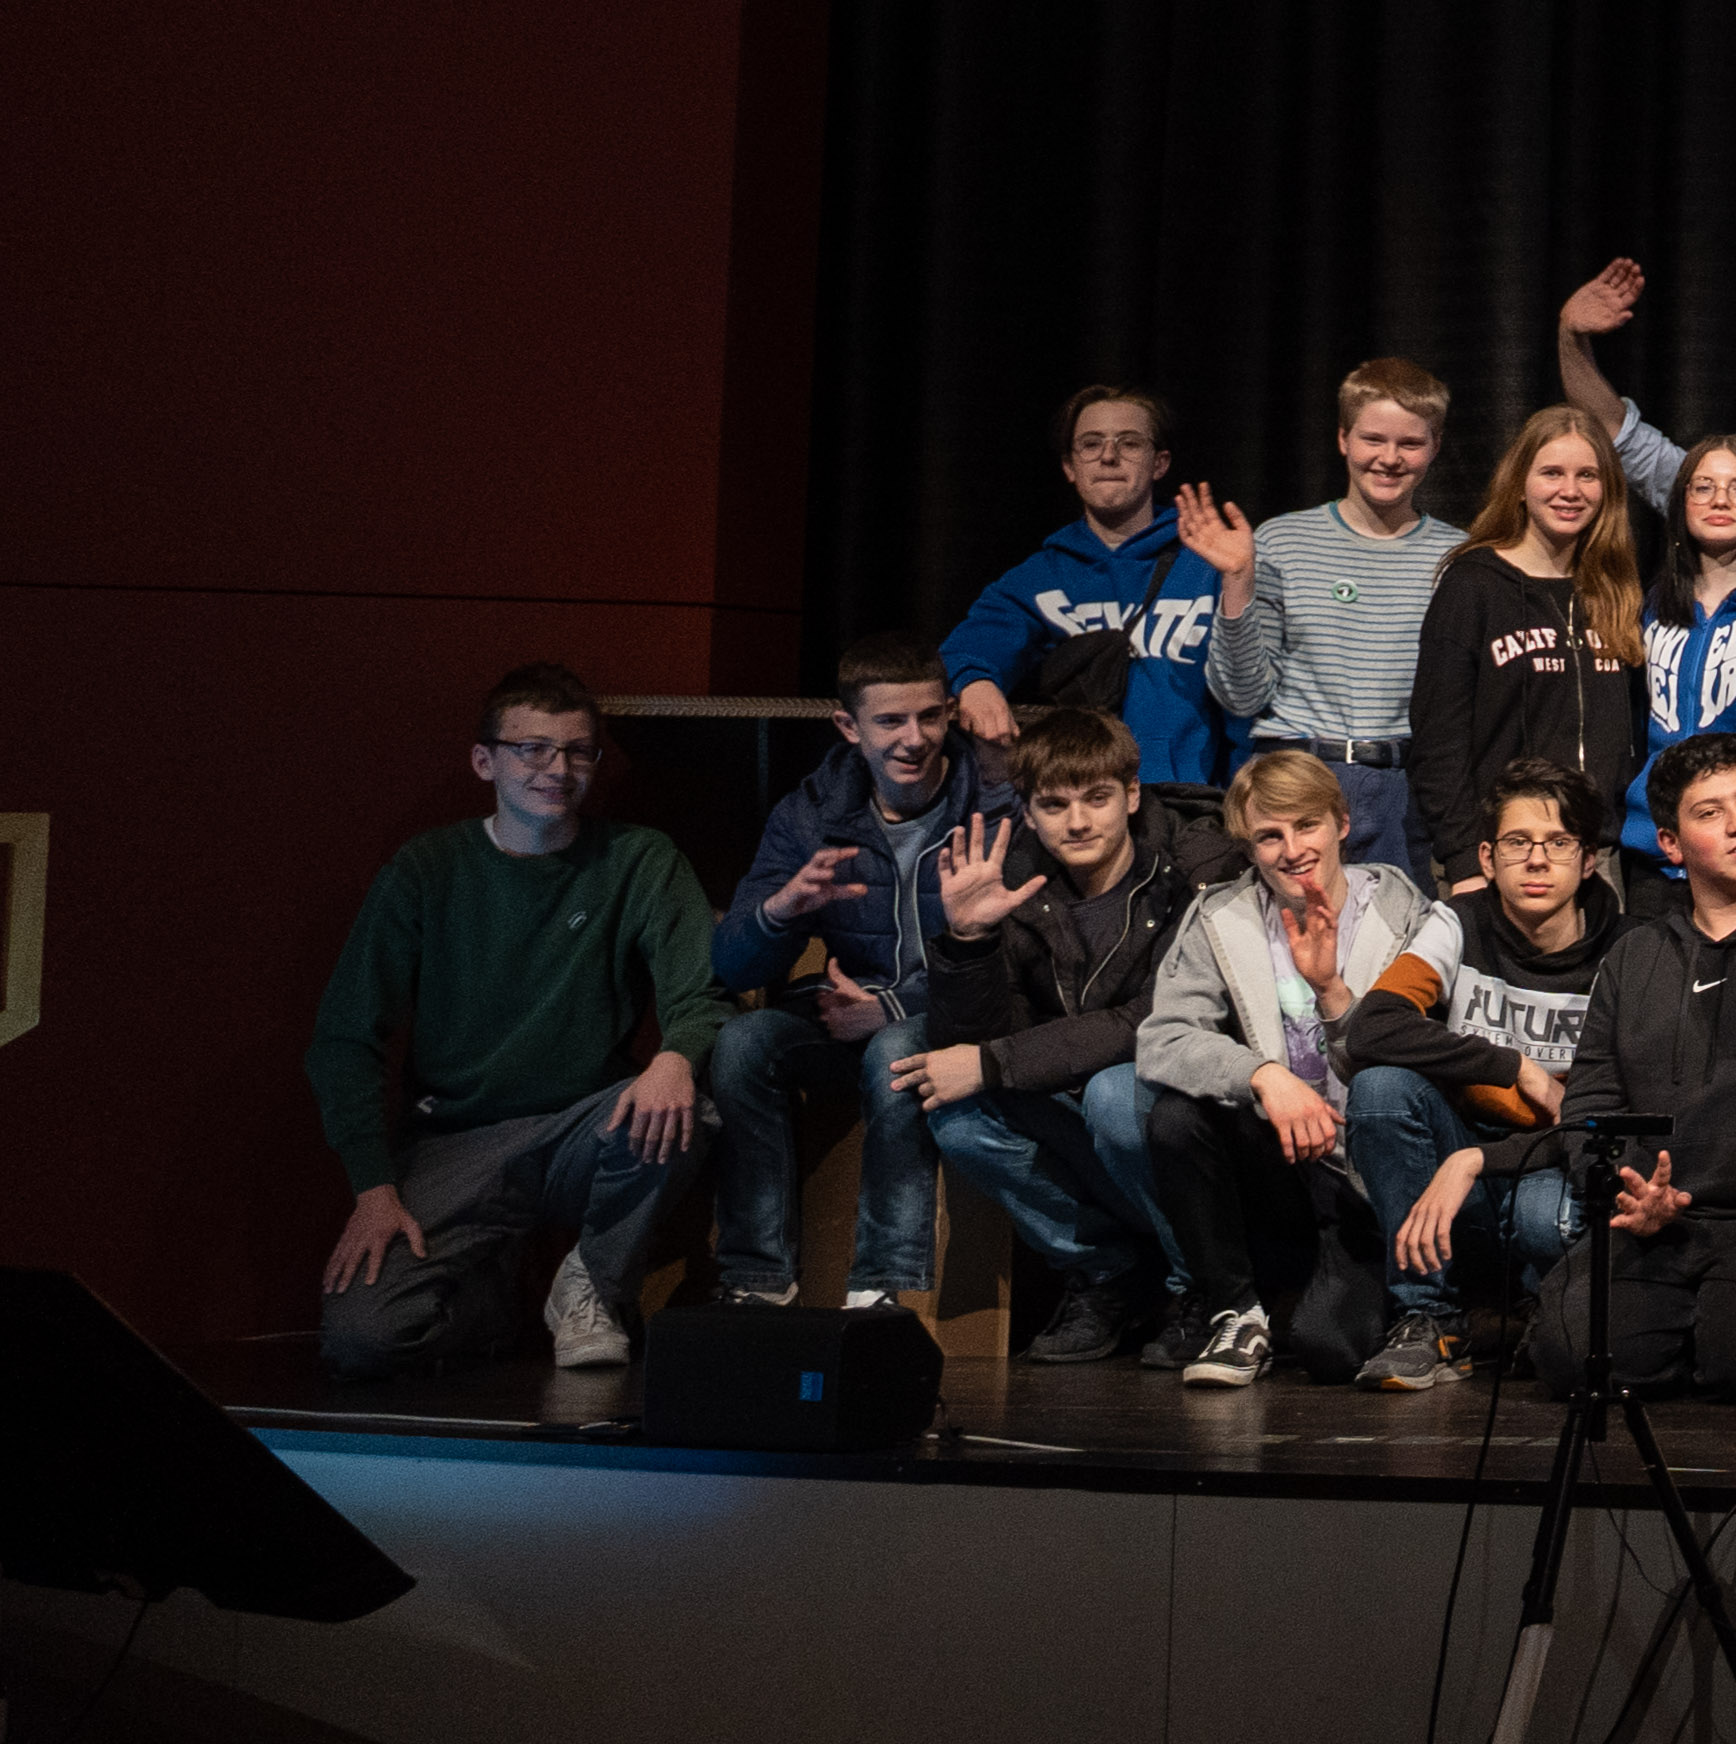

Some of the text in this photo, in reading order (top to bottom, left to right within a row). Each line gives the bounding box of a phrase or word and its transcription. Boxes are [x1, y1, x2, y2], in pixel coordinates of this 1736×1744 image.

[1532, 657, 1622, 673] WEST COA
[1463, 984, 1588, 1046] FUTUR
[1523, 1046, 1578, 1060] OVER
